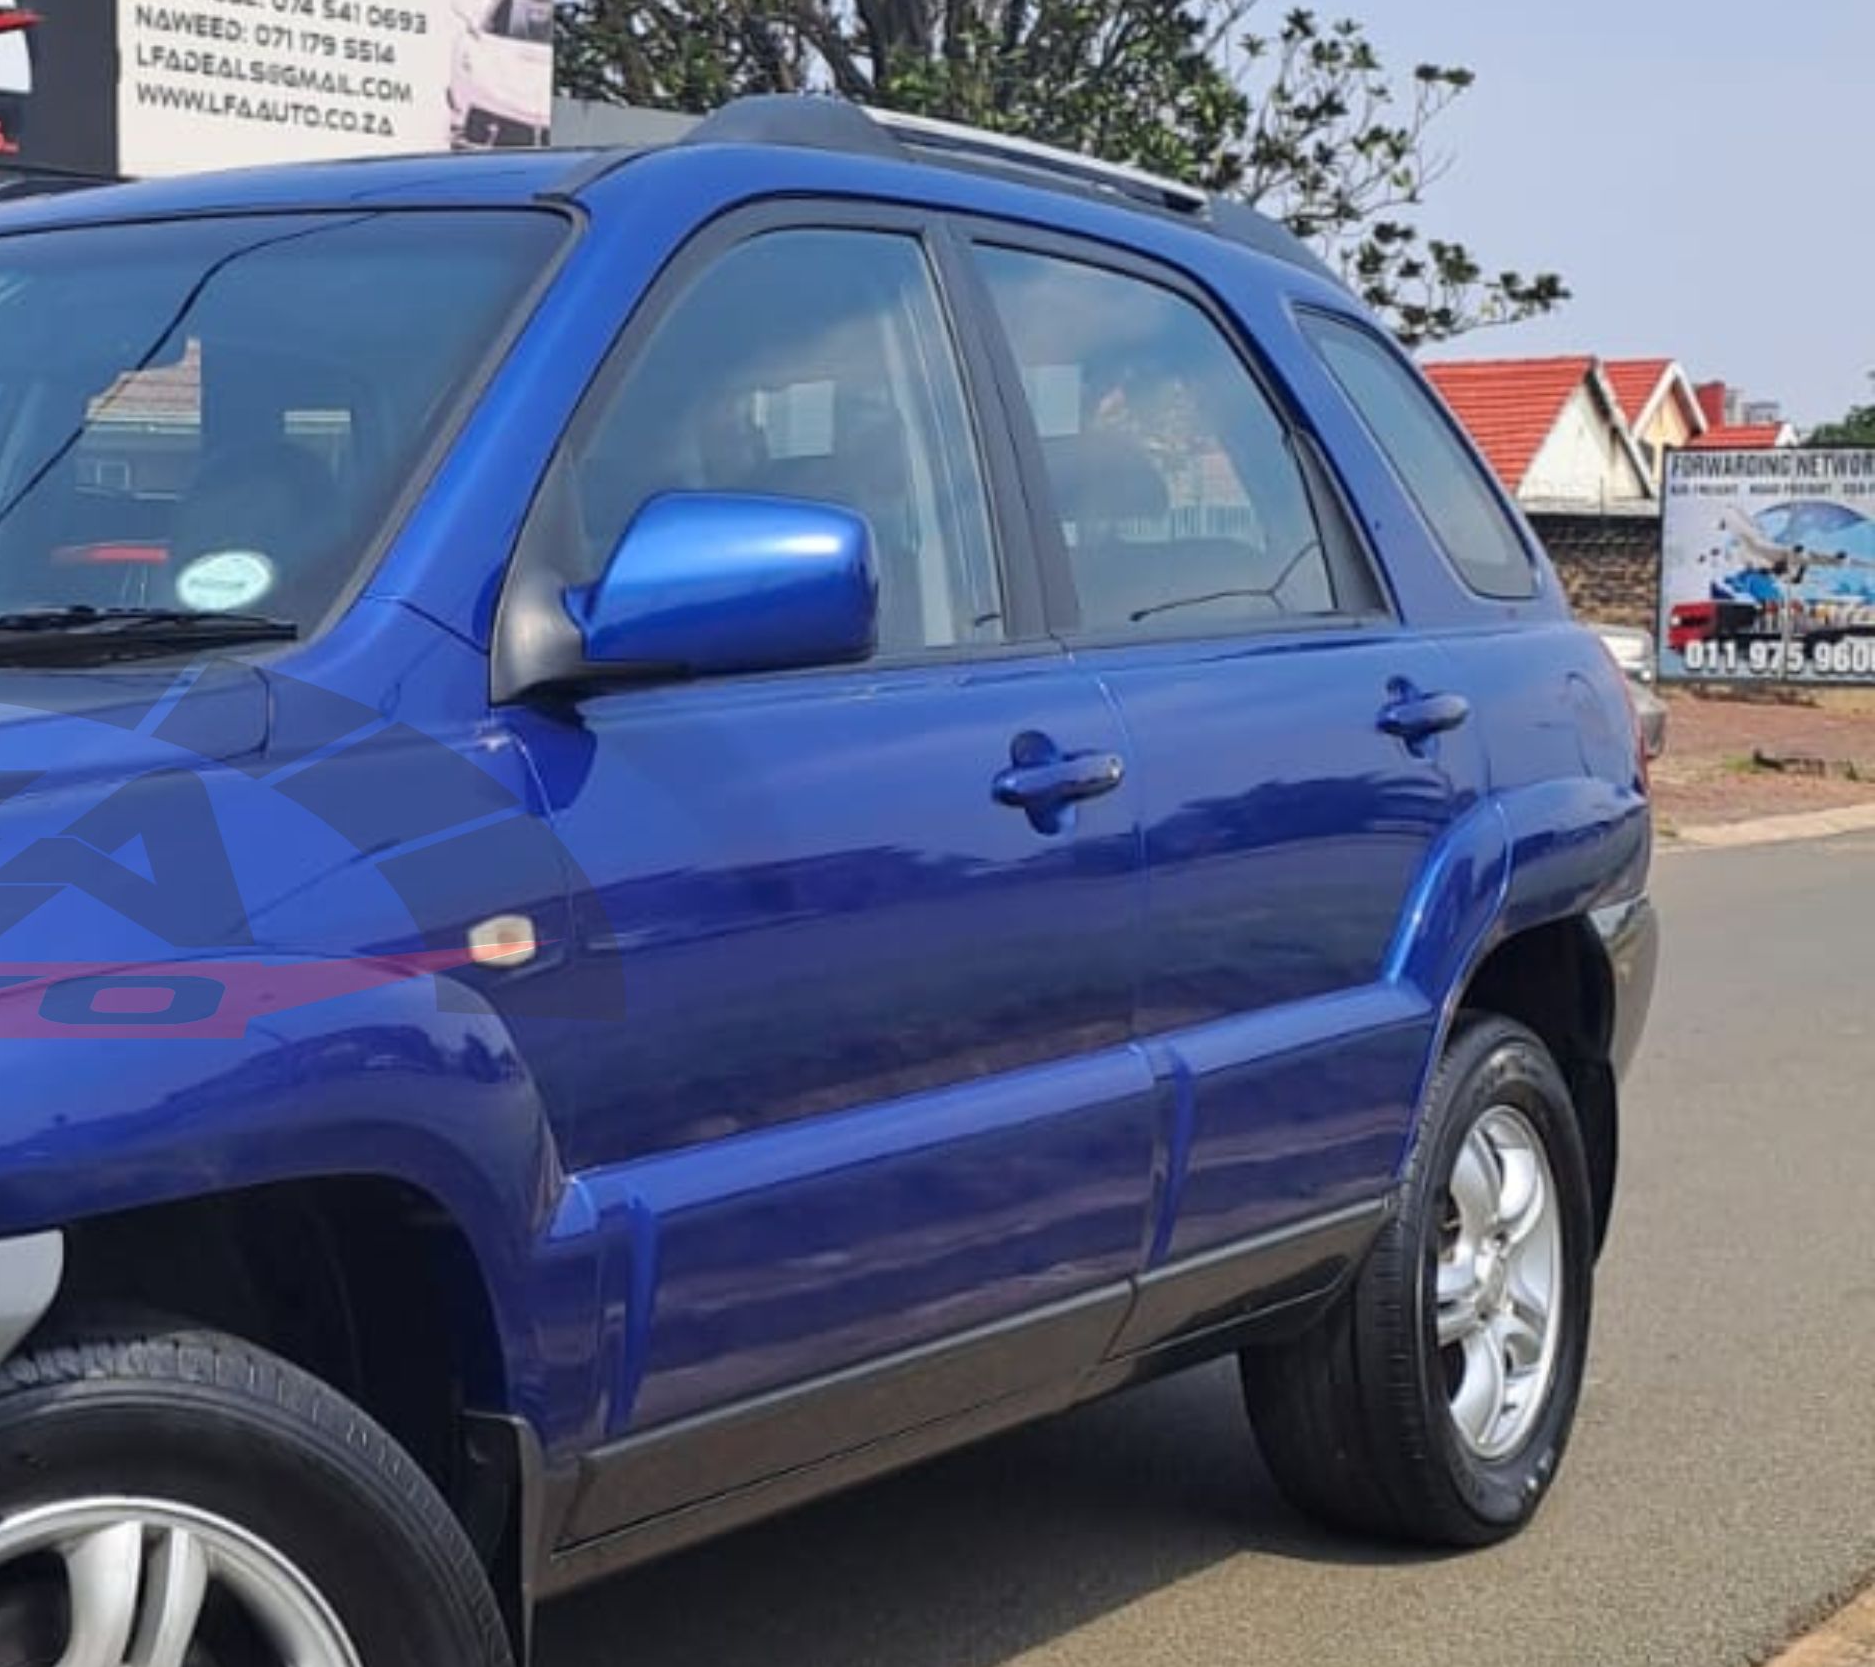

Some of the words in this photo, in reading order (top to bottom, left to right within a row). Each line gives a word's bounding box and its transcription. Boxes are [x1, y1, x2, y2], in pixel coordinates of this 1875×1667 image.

[135, 5, 247, 42] NAWEED:
[255, 23, 292, 51] 071
[300, 32, 337, 57] 179
[343, 37, 396, 64] 5514
[136, 82, 394, 137] WWW.LFAAUTO.CO.ZA
[1686, 639, 1735, 670] 011
[1814, 641, 1875, 673] 960
